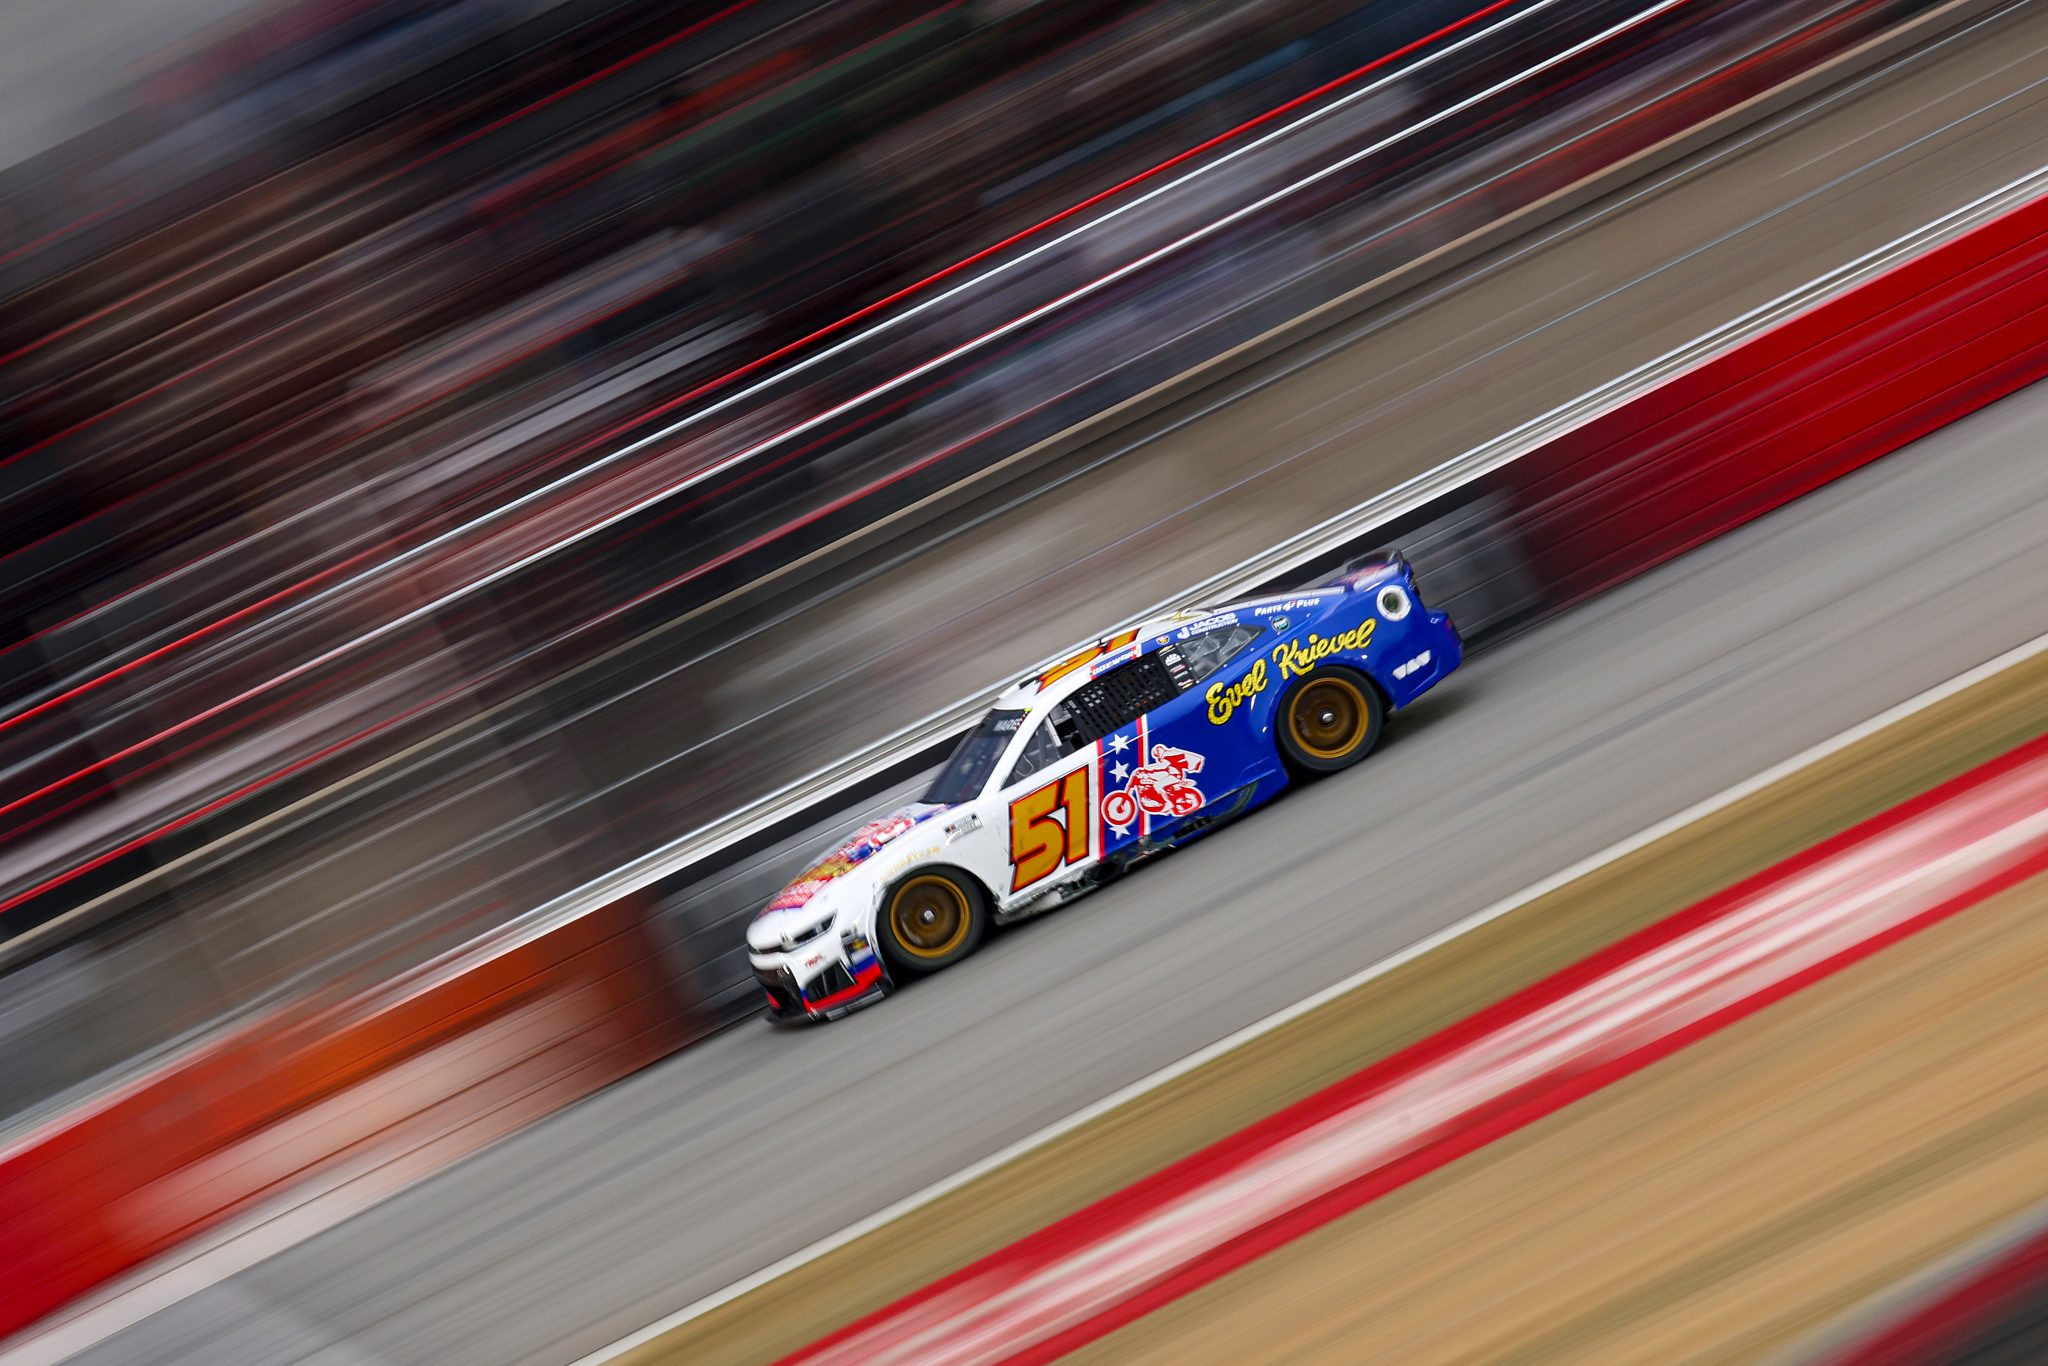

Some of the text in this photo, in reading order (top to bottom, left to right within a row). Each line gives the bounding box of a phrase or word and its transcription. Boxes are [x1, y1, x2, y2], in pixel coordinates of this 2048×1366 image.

[1254, 598, 1320, 616] PARTS PLUS
[1190, 612, 1237, 630] JACOB
[1190, 619, 1239, 635] CONSTRUCTION
[1205, 617, 1377, 725] Evel Knievel
[1008, 763, 1090, 896] 51
